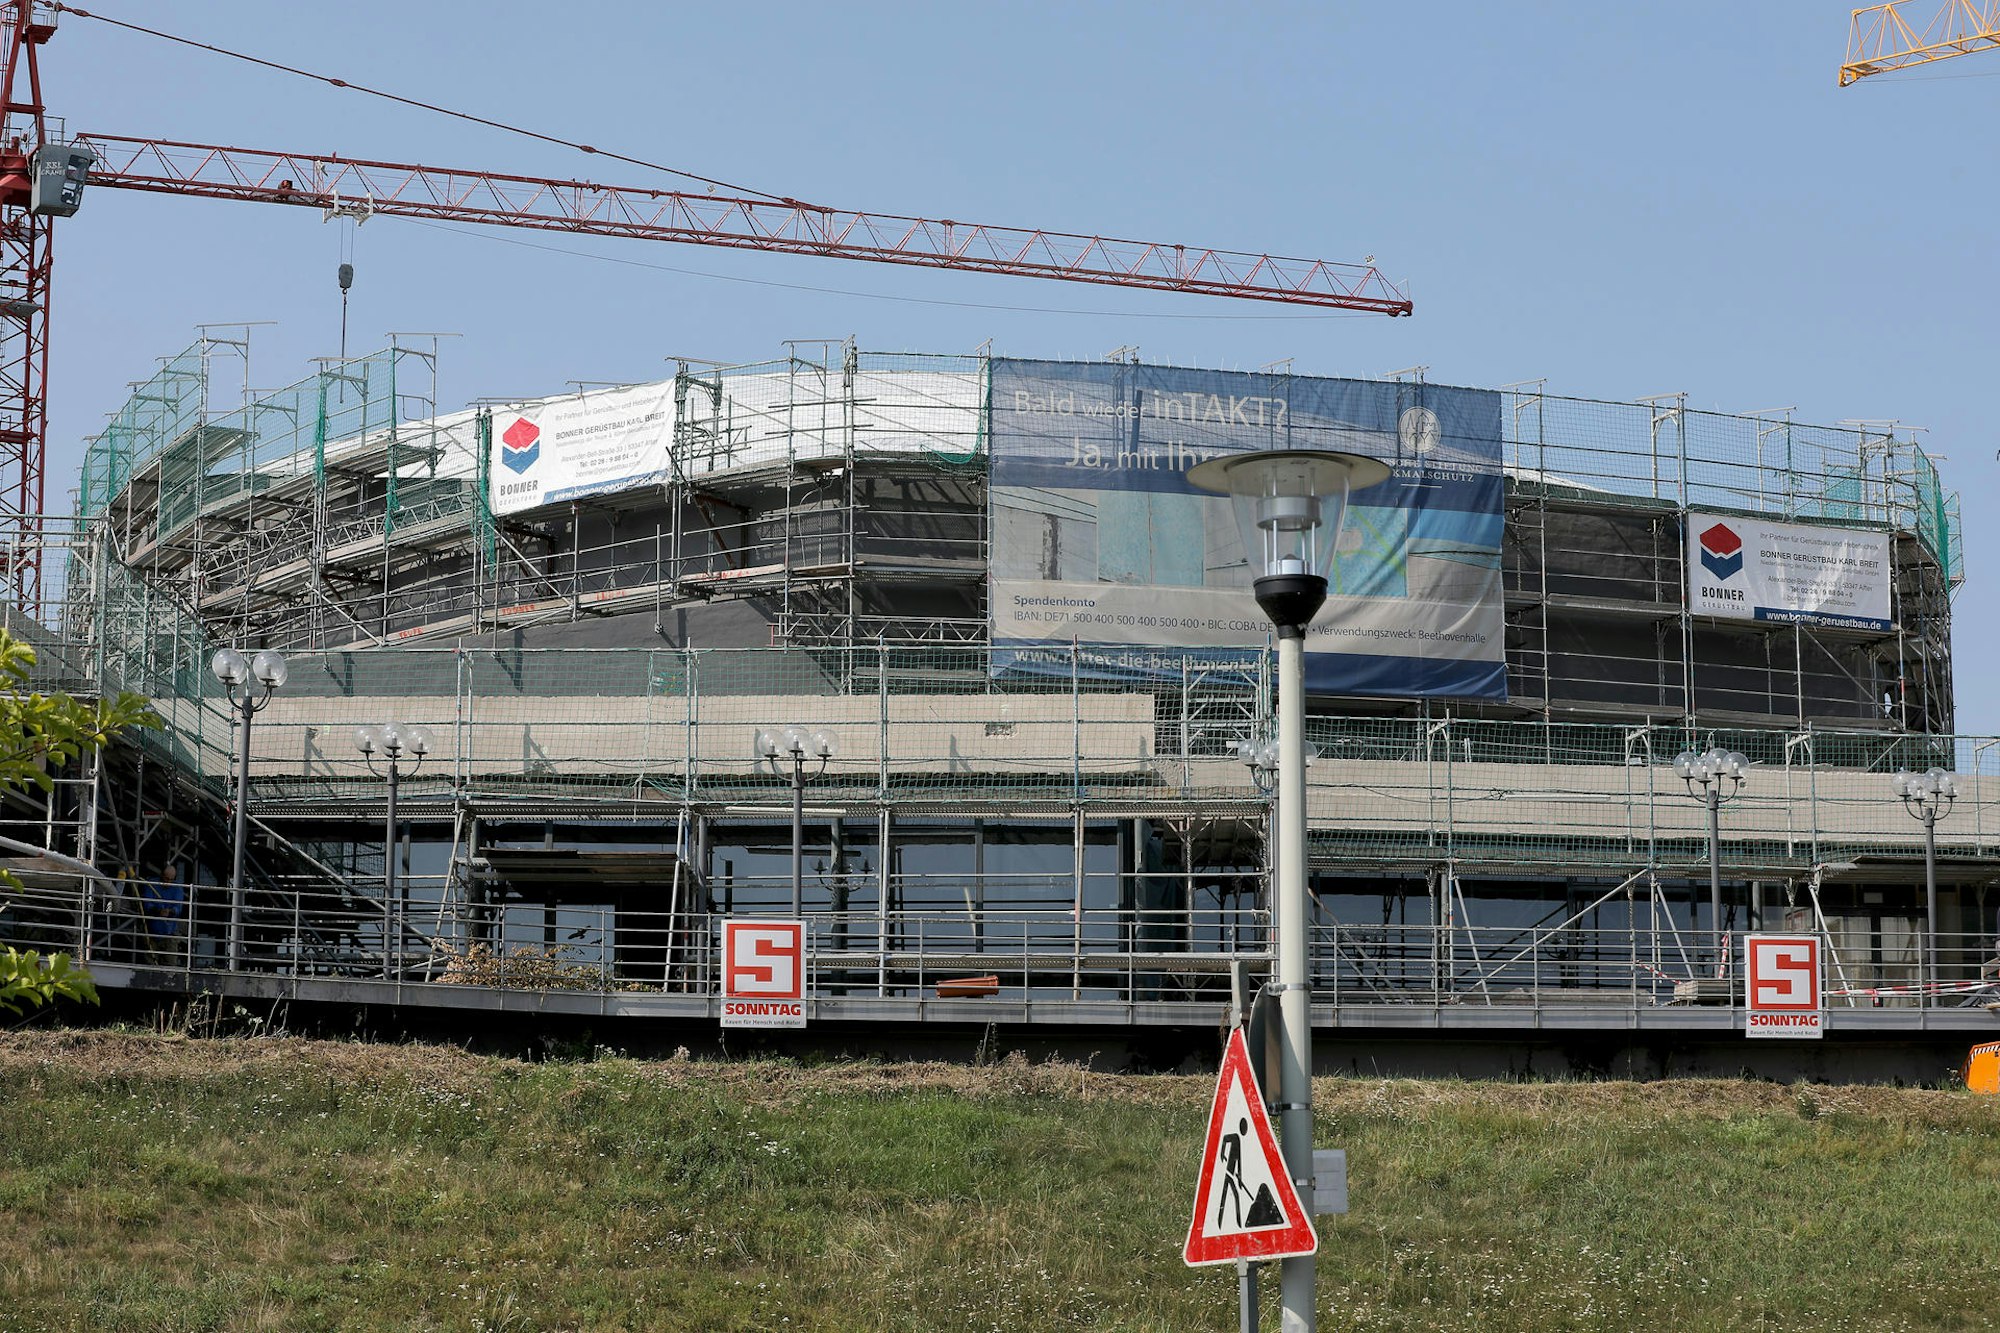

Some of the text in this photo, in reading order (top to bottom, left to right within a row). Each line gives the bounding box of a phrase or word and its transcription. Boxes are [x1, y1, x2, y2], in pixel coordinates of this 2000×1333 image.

[1015, 390, 1288, 430] Bald wieder inTAKT?
[556, 428, 584, 440] BONNER
[585, 420, 627, 435] GERÜSTBAU
[644, 411, 665, 422] BREIT
[1065, 436, 1228, 472] Ja, mit Ihr
[1392, 469, 1475, 482] KMALSCHUTZ
[500, 480, 539, 496] BONNER
[1760, 550, 1880, 569] BONNER GERÜSTBAU KARL BREIT
[1014, 595, 1096, 609] Spendenkonto
[1701, 586, 1745, 601] BONNER
[1014, 611, 1043, 622] IBAN:
[1044, 611, 1070, 623] DE71
[1073, 612, 1093, 624] 500
[1095, 614, 1114, 625] 400
[1116, 615, 1136, 626] 500
[1137, 616, 1157, 627] 400
[1159, 617, 1178, 628] 500
[1180, 618, 1200, 629] 400
[1207, 619, 1227, 630] BIC:
[1228, 620, 1257, 632] COBA
[1259, 621, 1274, 632] DE
[1317, 626, 1417, 640] Verwendungszweck:
[1418, 630, 1486, 644] Beethovenhalle
[1766, 611, 1882, 631] www.bonner-geruestbau.de
[725, 1003, 801, 1016] SONNTAG
[1750, 1014, 1819, 1027] SONNTAG
